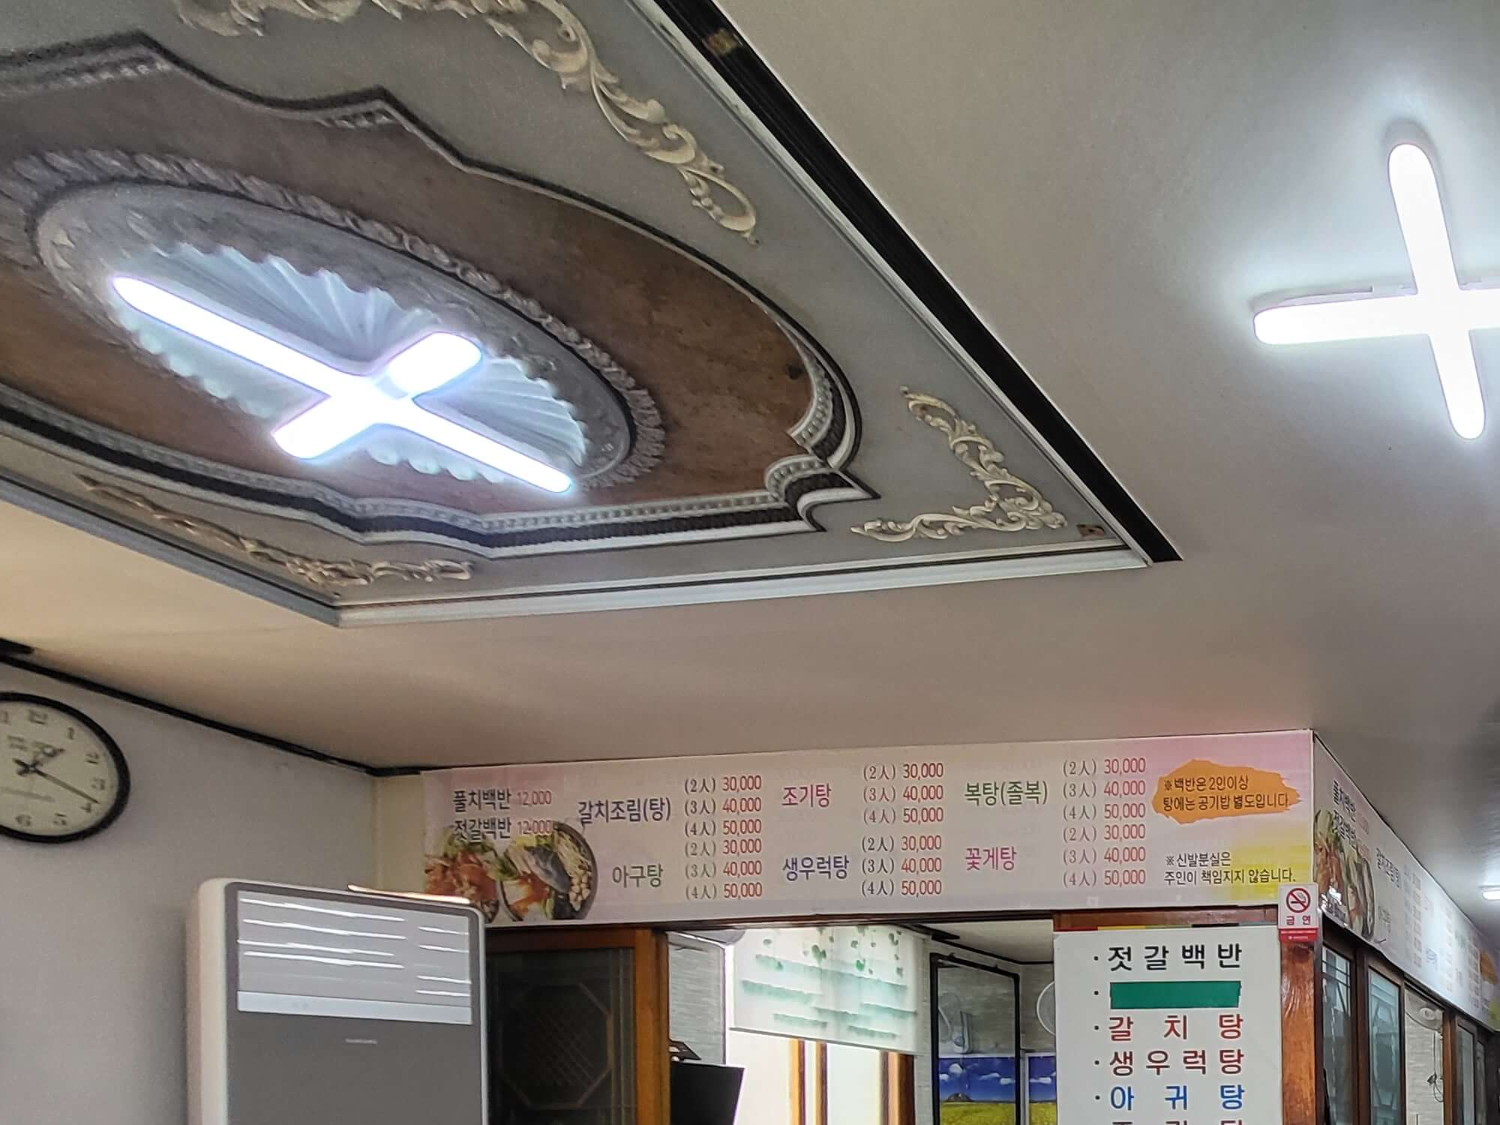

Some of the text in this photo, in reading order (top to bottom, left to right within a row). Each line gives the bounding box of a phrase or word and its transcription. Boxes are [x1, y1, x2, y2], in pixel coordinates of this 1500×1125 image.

[902, 762, 944, 780] 30,000
[1103, 756, 1147, 777] 30,000
[722, 775, 762, 793] 30,000
[1103, 779, 1147, 799] 40,000
[1209, 775, 1249, 790] 2인이상
[452, 788, 512, 812] 풀치백반
[781, 783, 832, 808] 조기탕
[902, 784, 944, 802] 40,000
[964, 779, 1049, 806] 복탕(졸복)
[578, 797, 672, 825] 갈치조림(탕)
[722, 797, 762, 815] 40,000
[1104, 802, 1147, 821] 50,000
[1198, 795, 1231, 811] 공기밥
[903, 807, 944, 825] 50,000
[453, 817, 512, 843] 젓갈백반
[722, 818, 762, 837] 50,000
[1104, 823, 1147, 844] 30,000
[722, 838, 762, 856] 30,000
[900, 834, 942, 852] 30,000
[964, 845, 1018, 871] 꽃게탕
[1104, 846, 1147, 866] 40,000
[722, 860, 763, 877] 40,000
[782, 855, 850, 882] 생우럭탕
[900, 857, 942, 875] 40,000
[612, 863, 664, 889] 아구탕
[1104, 868, 1147, 889] 50,000
[1164, 868, 1296, 885] 주인이 책임지지 않습니다.
[723, 881, 763, 900] 50,000
[901, 879, 942, 898] 50,000
